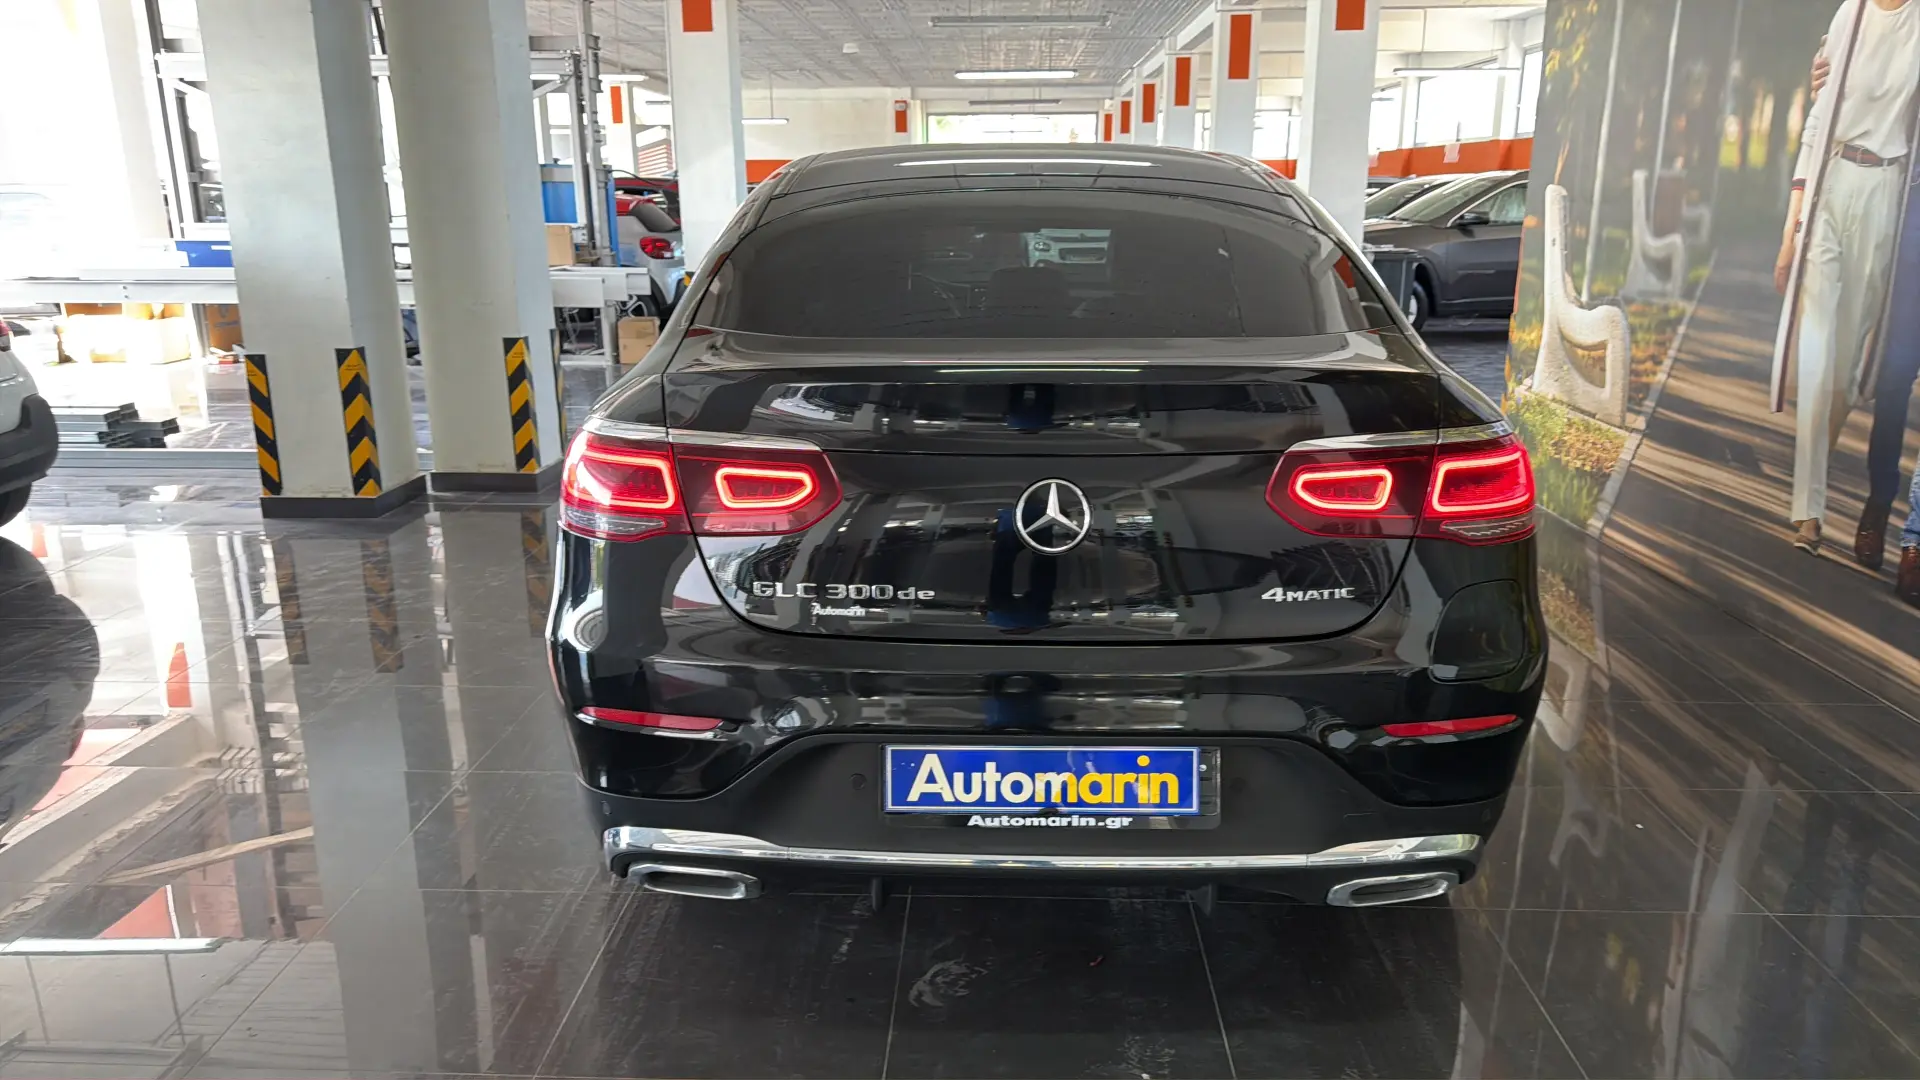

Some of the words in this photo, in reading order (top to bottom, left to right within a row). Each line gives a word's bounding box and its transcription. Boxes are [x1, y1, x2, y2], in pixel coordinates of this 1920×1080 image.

[752, 581, 818, 599] GLC
[825, 583, 894, 600] 300
[897, 586, 936, 600] de
[1261, 587, 1355, 602] 4MATIC
[906, 753, 1180, 804] Automarin
[967, 814, 1133, 829] Automarin.gr
